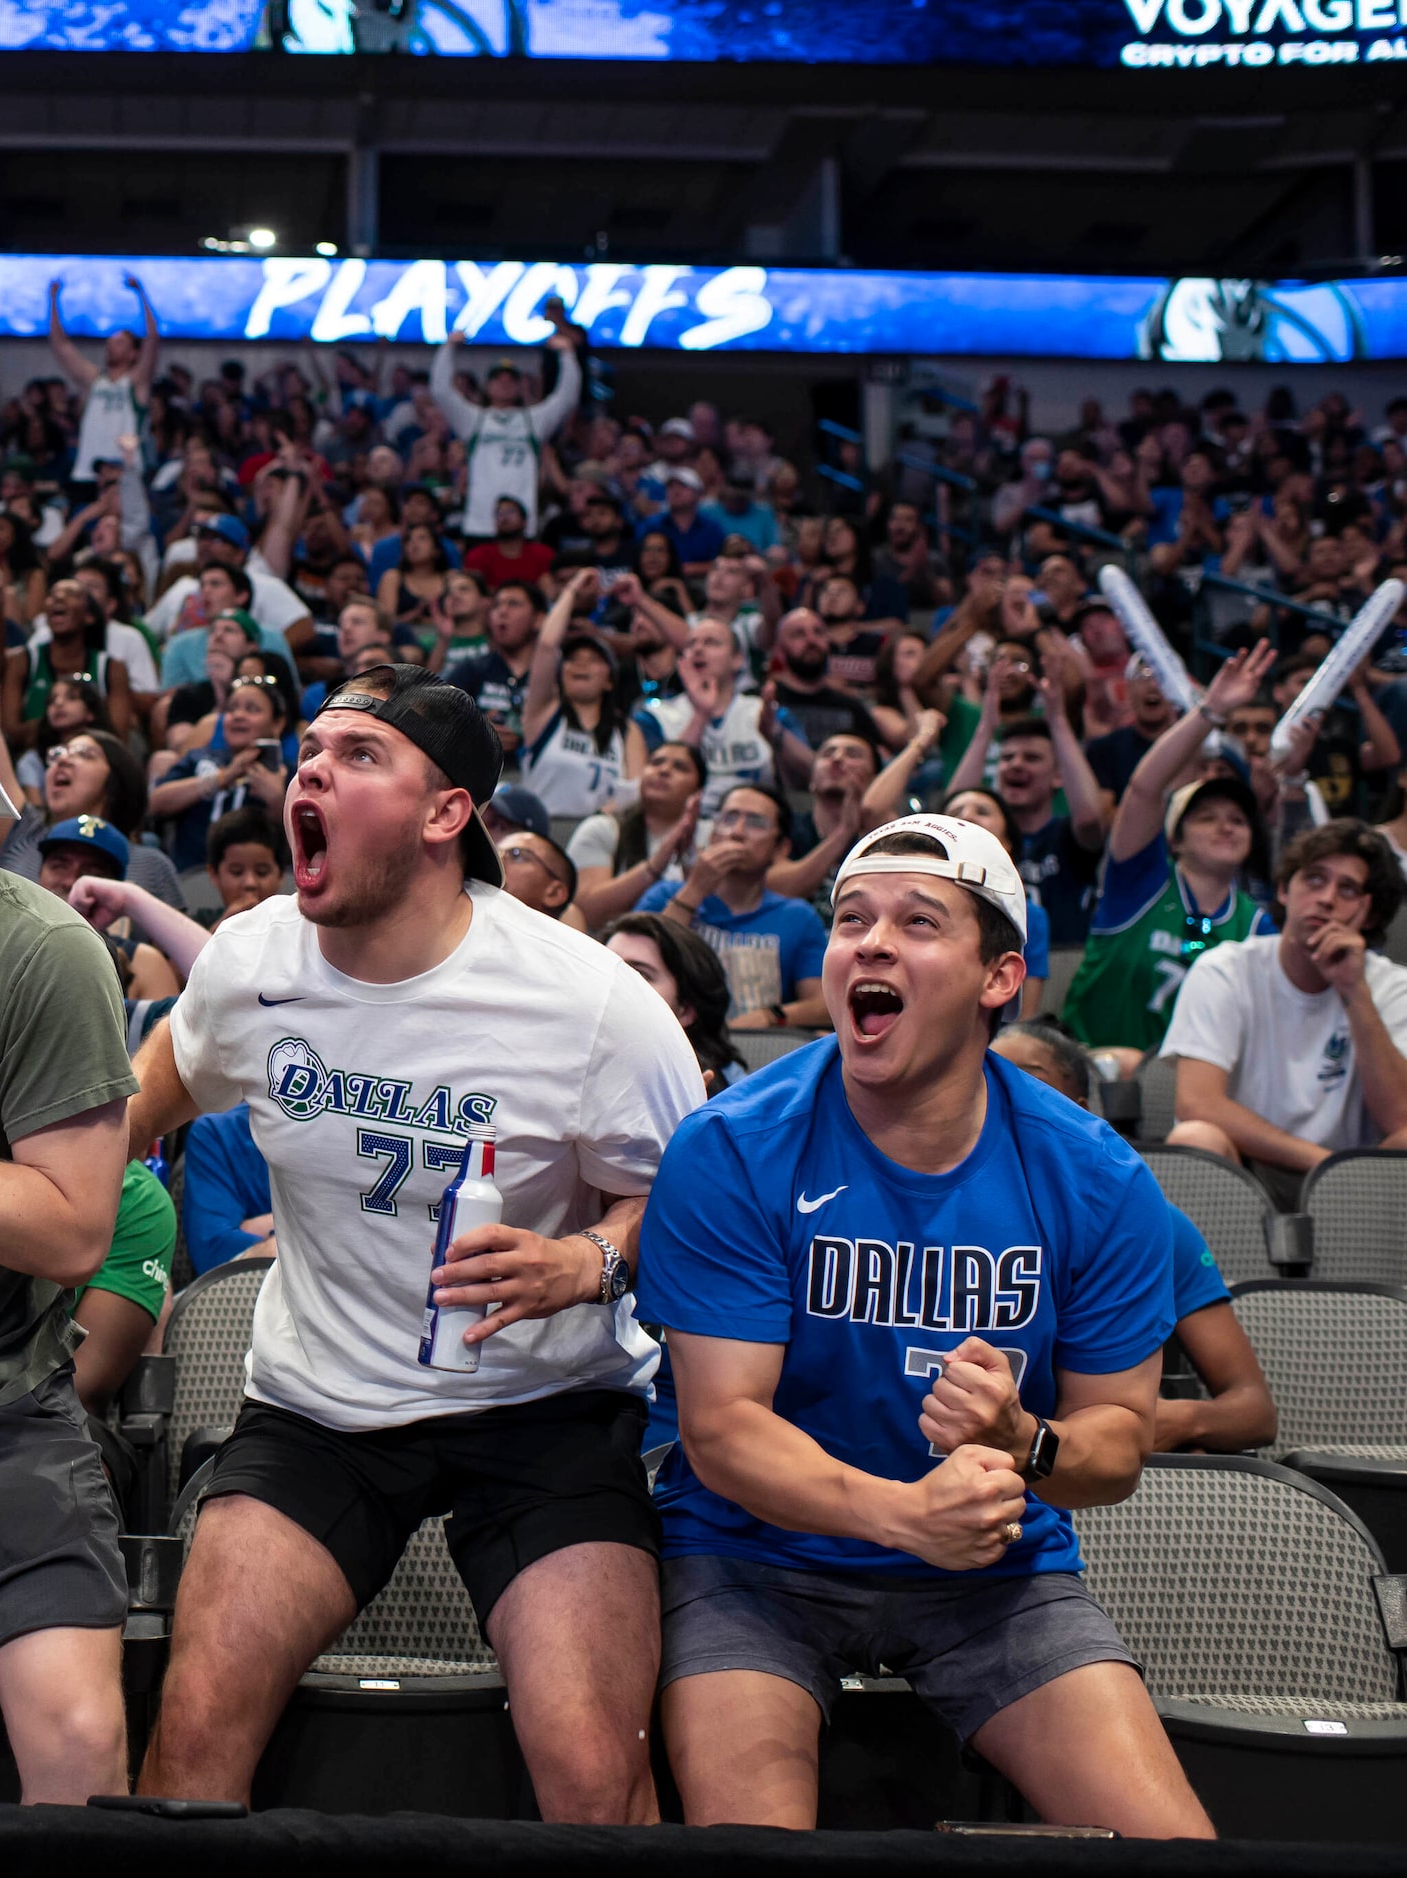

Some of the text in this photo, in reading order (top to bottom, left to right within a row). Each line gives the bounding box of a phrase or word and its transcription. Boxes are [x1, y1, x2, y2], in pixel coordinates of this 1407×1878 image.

[1120, 41, 1275, 68] CRYPTO
[1278, 41, 1360, 65] FOR
[244, 256, 774, 350] PLAYOFFS
[271, 1050, 498, 1140] DALLAS
[806, 1234, 1042, 1332] DALLAS
